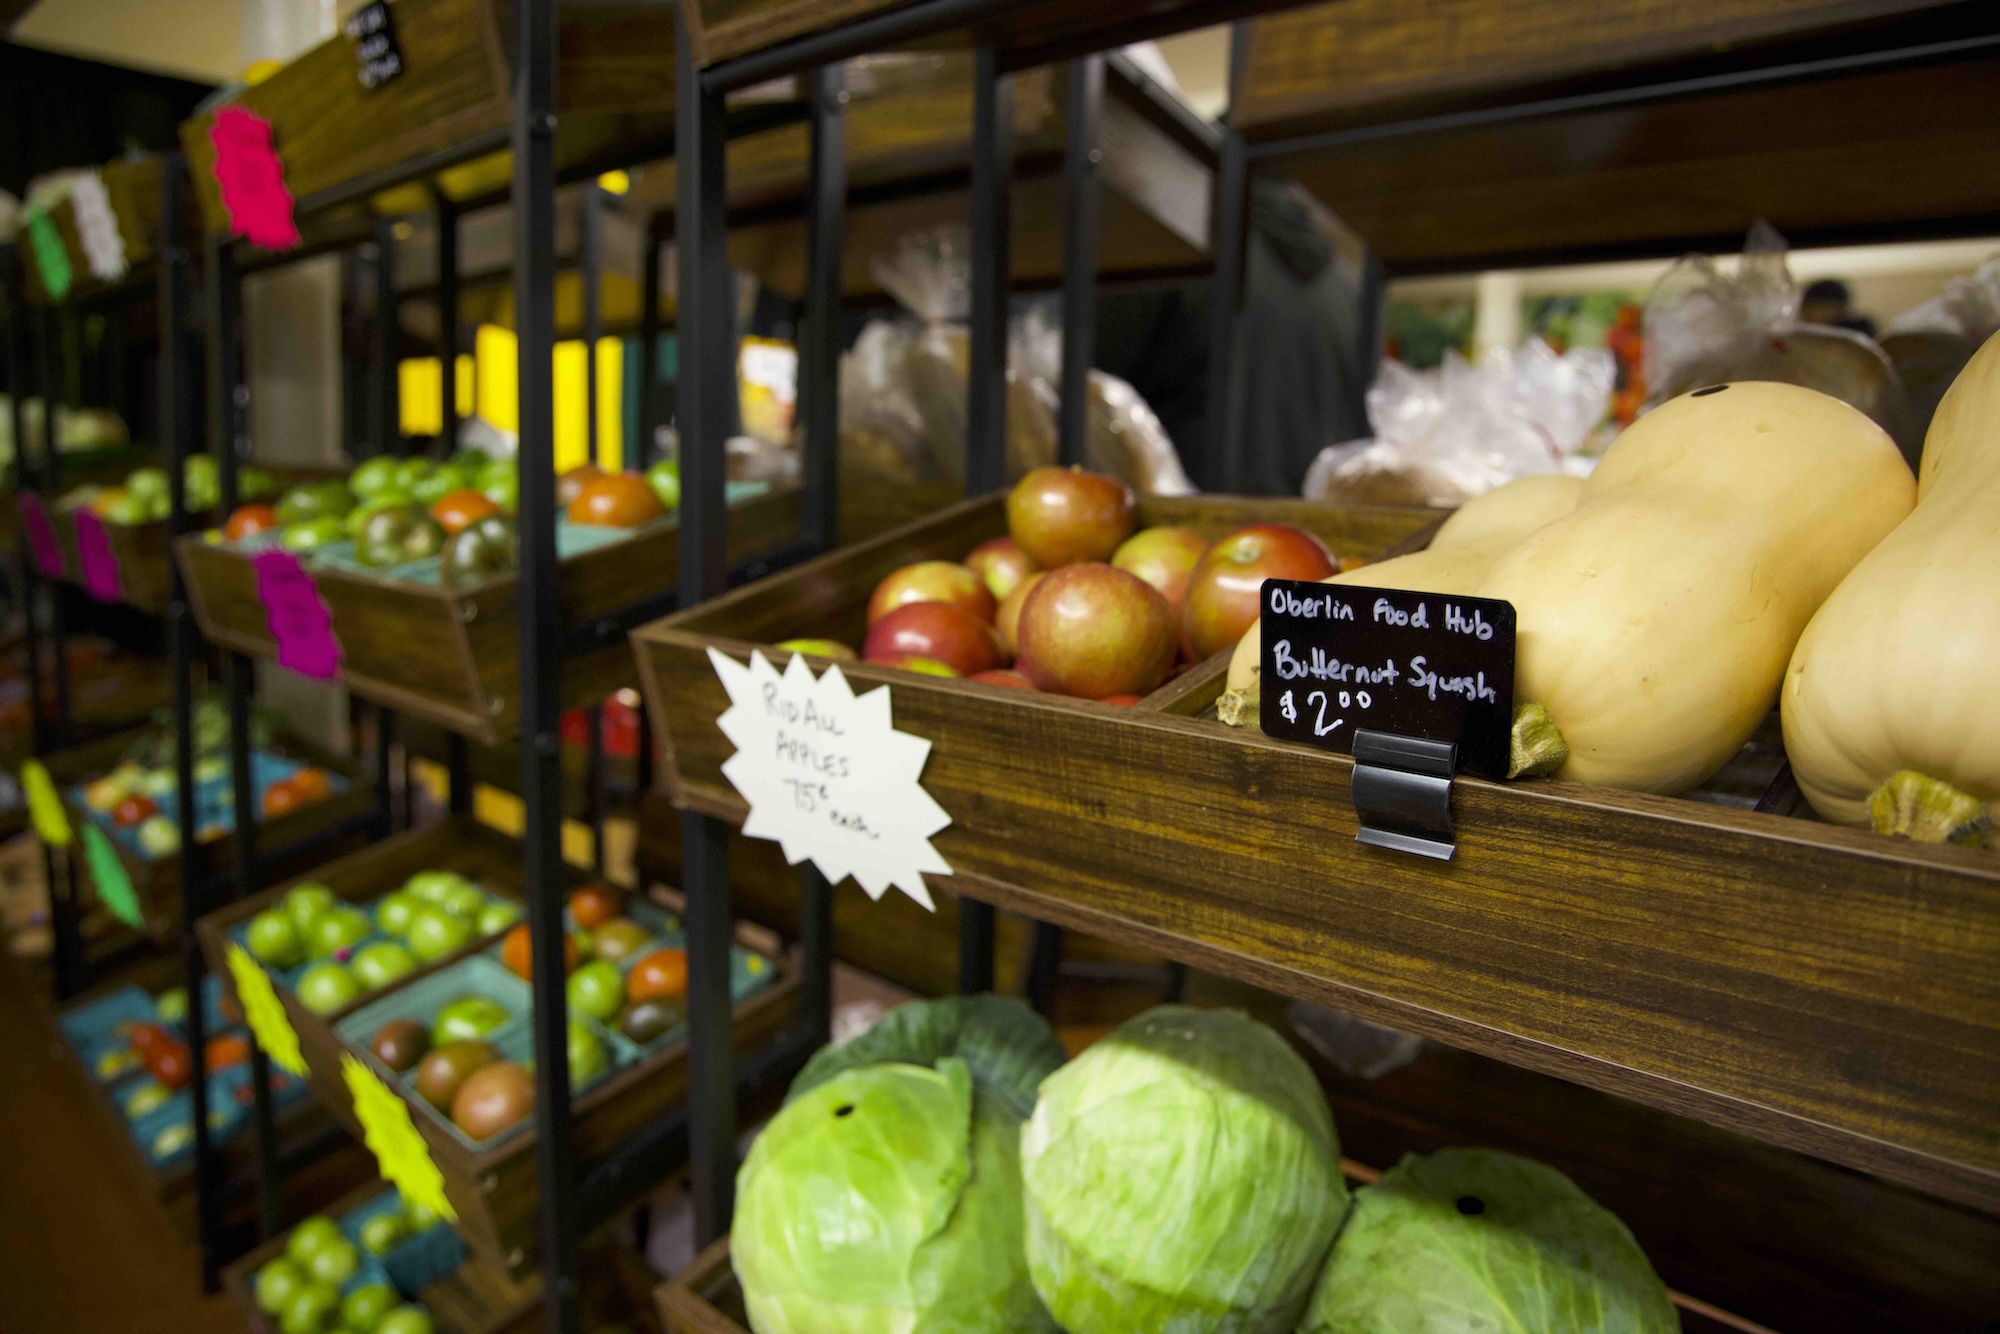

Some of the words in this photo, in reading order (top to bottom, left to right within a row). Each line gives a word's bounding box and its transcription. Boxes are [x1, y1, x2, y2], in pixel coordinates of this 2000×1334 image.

[1270, 587, 1354, 622] Oberlin
[1373, 597, 1430, 628] Food
[1445, 603, 1494, 641] Hub
[1273, 639, 1400, 686] Butternut
[1408, 655, 1497, 704] Squash
[776, 730, 850, 777] APPLES
